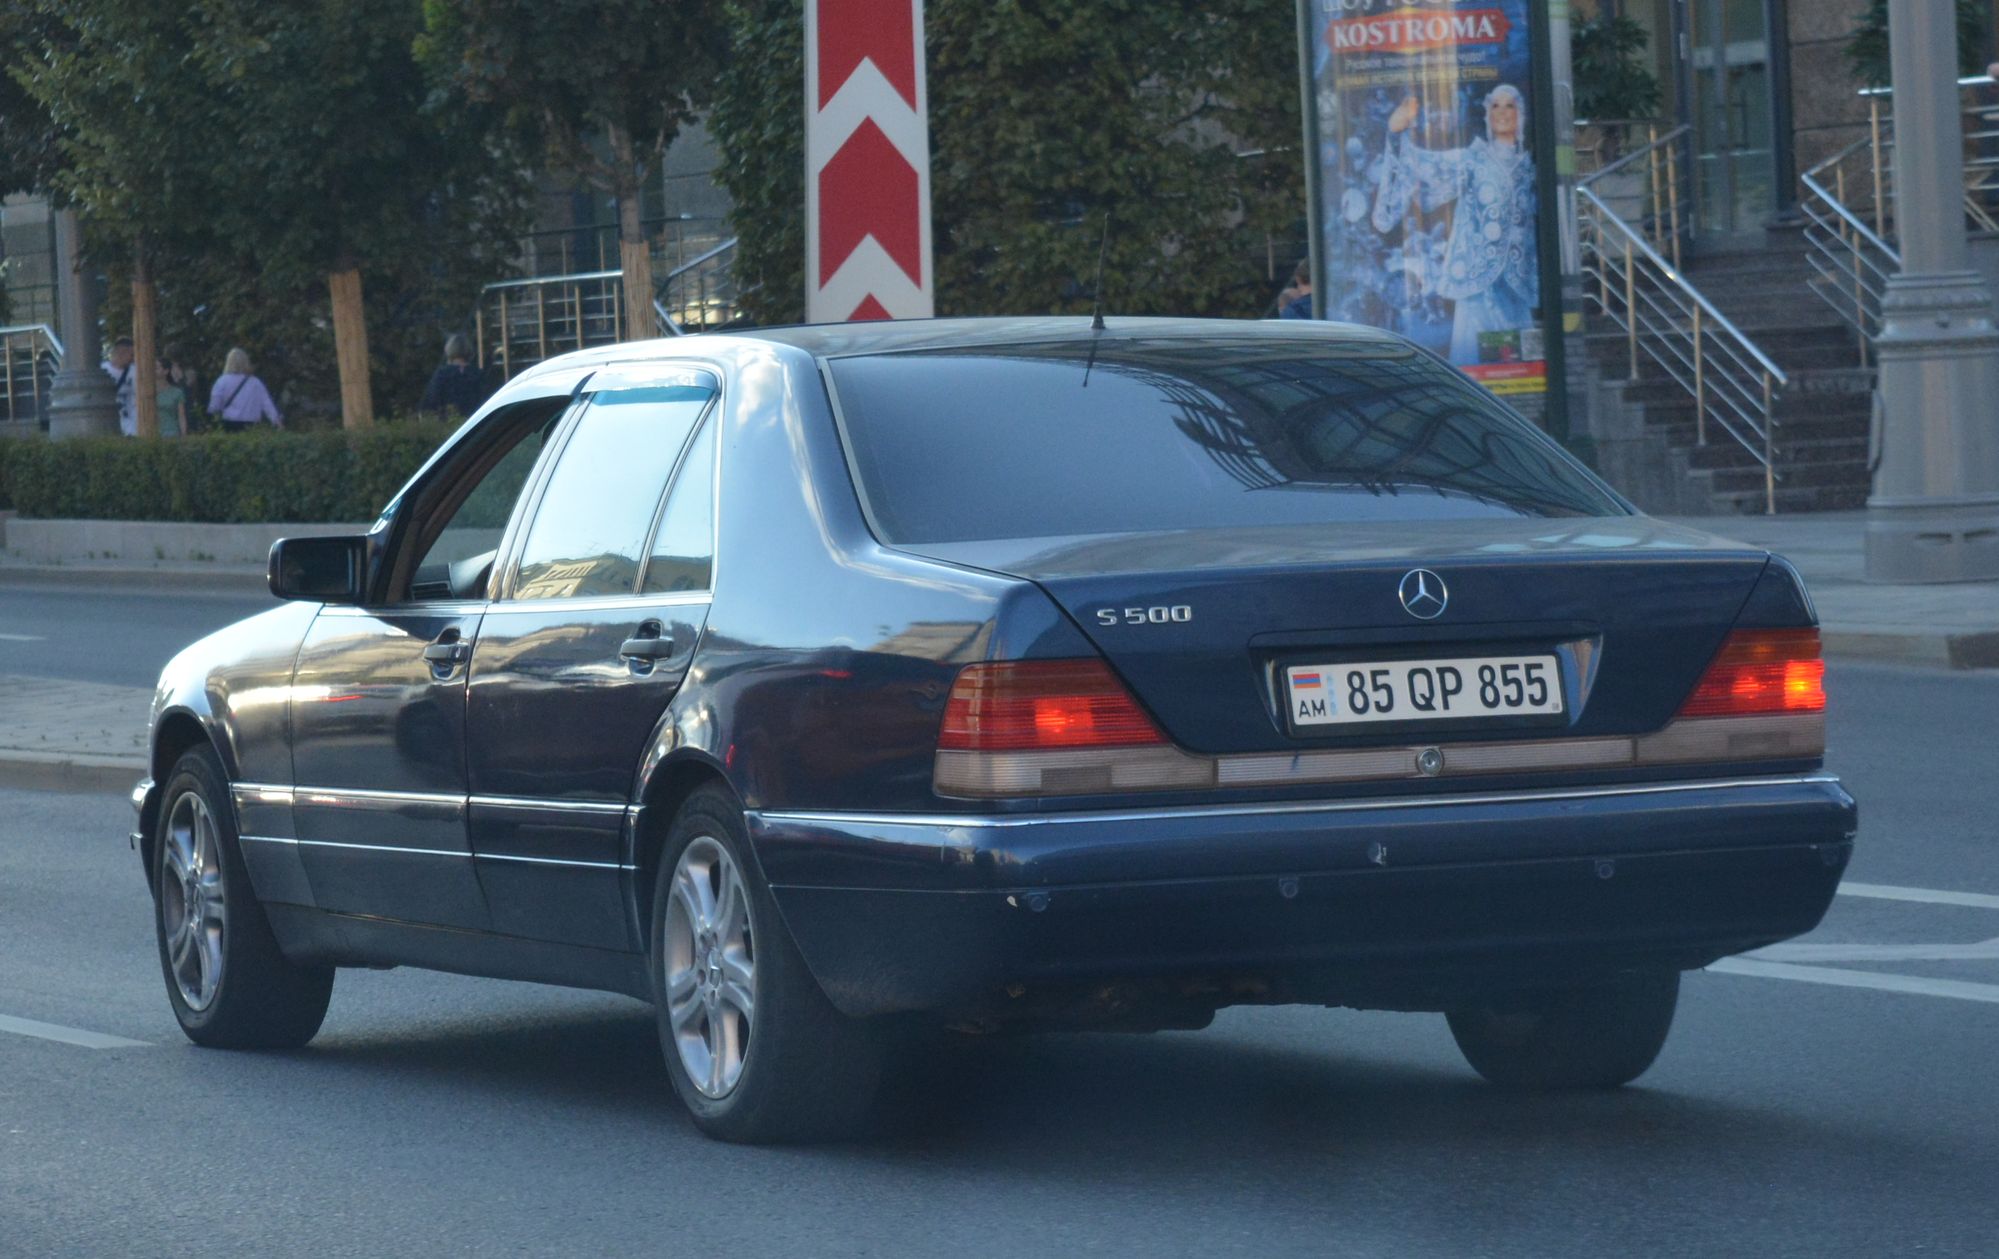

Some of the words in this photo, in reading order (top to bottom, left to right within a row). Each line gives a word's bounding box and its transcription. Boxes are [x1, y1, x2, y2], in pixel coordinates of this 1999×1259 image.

[1333, 15, 1496, 48] KOSTROMA
[1097, 608, 1117, 626] S
[1125, 605, 1192, 624] 500
[1347, 669, 1394, 715] 85
[1407, 667, 1463, 711] QP
[1478, 663, 1548, 708] 855
[1299, 698, 1326, 718] AM
